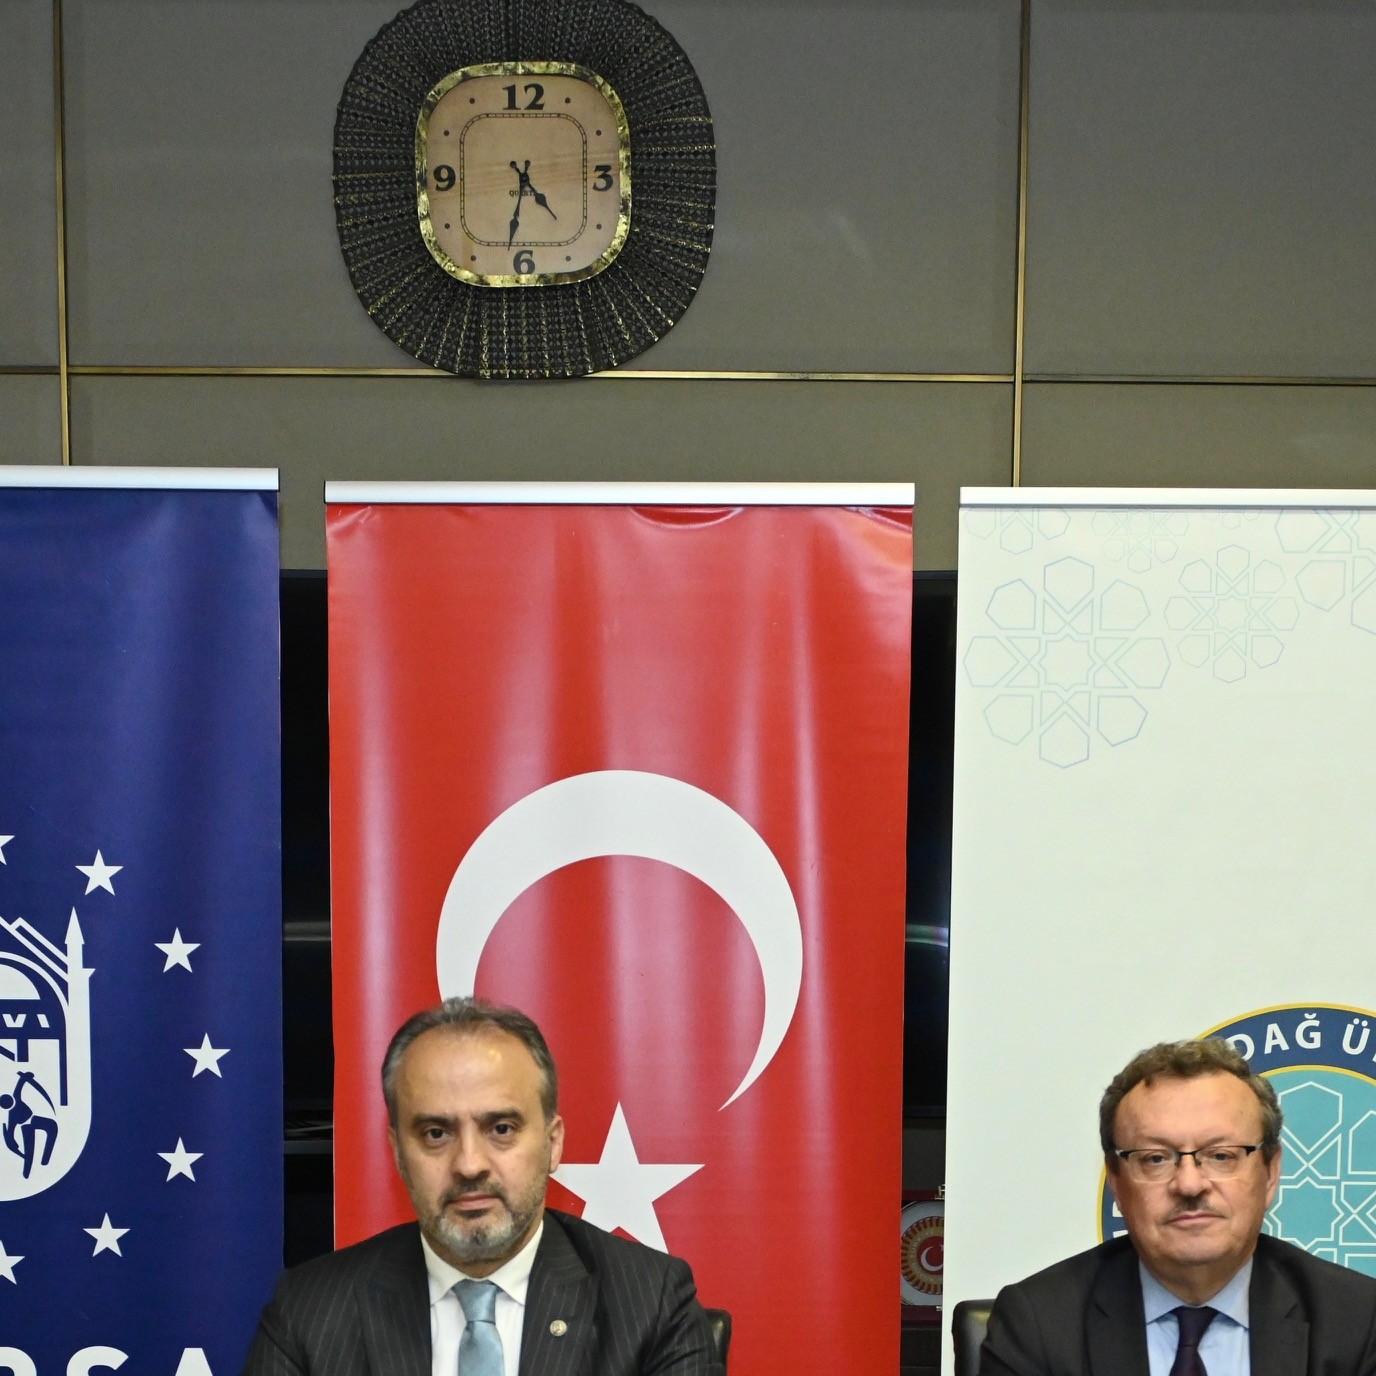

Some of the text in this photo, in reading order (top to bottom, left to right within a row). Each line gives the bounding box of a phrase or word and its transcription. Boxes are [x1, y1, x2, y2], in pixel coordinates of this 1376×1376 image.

[502, 83, 545, 111] 12
[432, 165, 456, 192] 9
[592, 165, 614, 192] 3
[512, 250, 536, 275] 6
